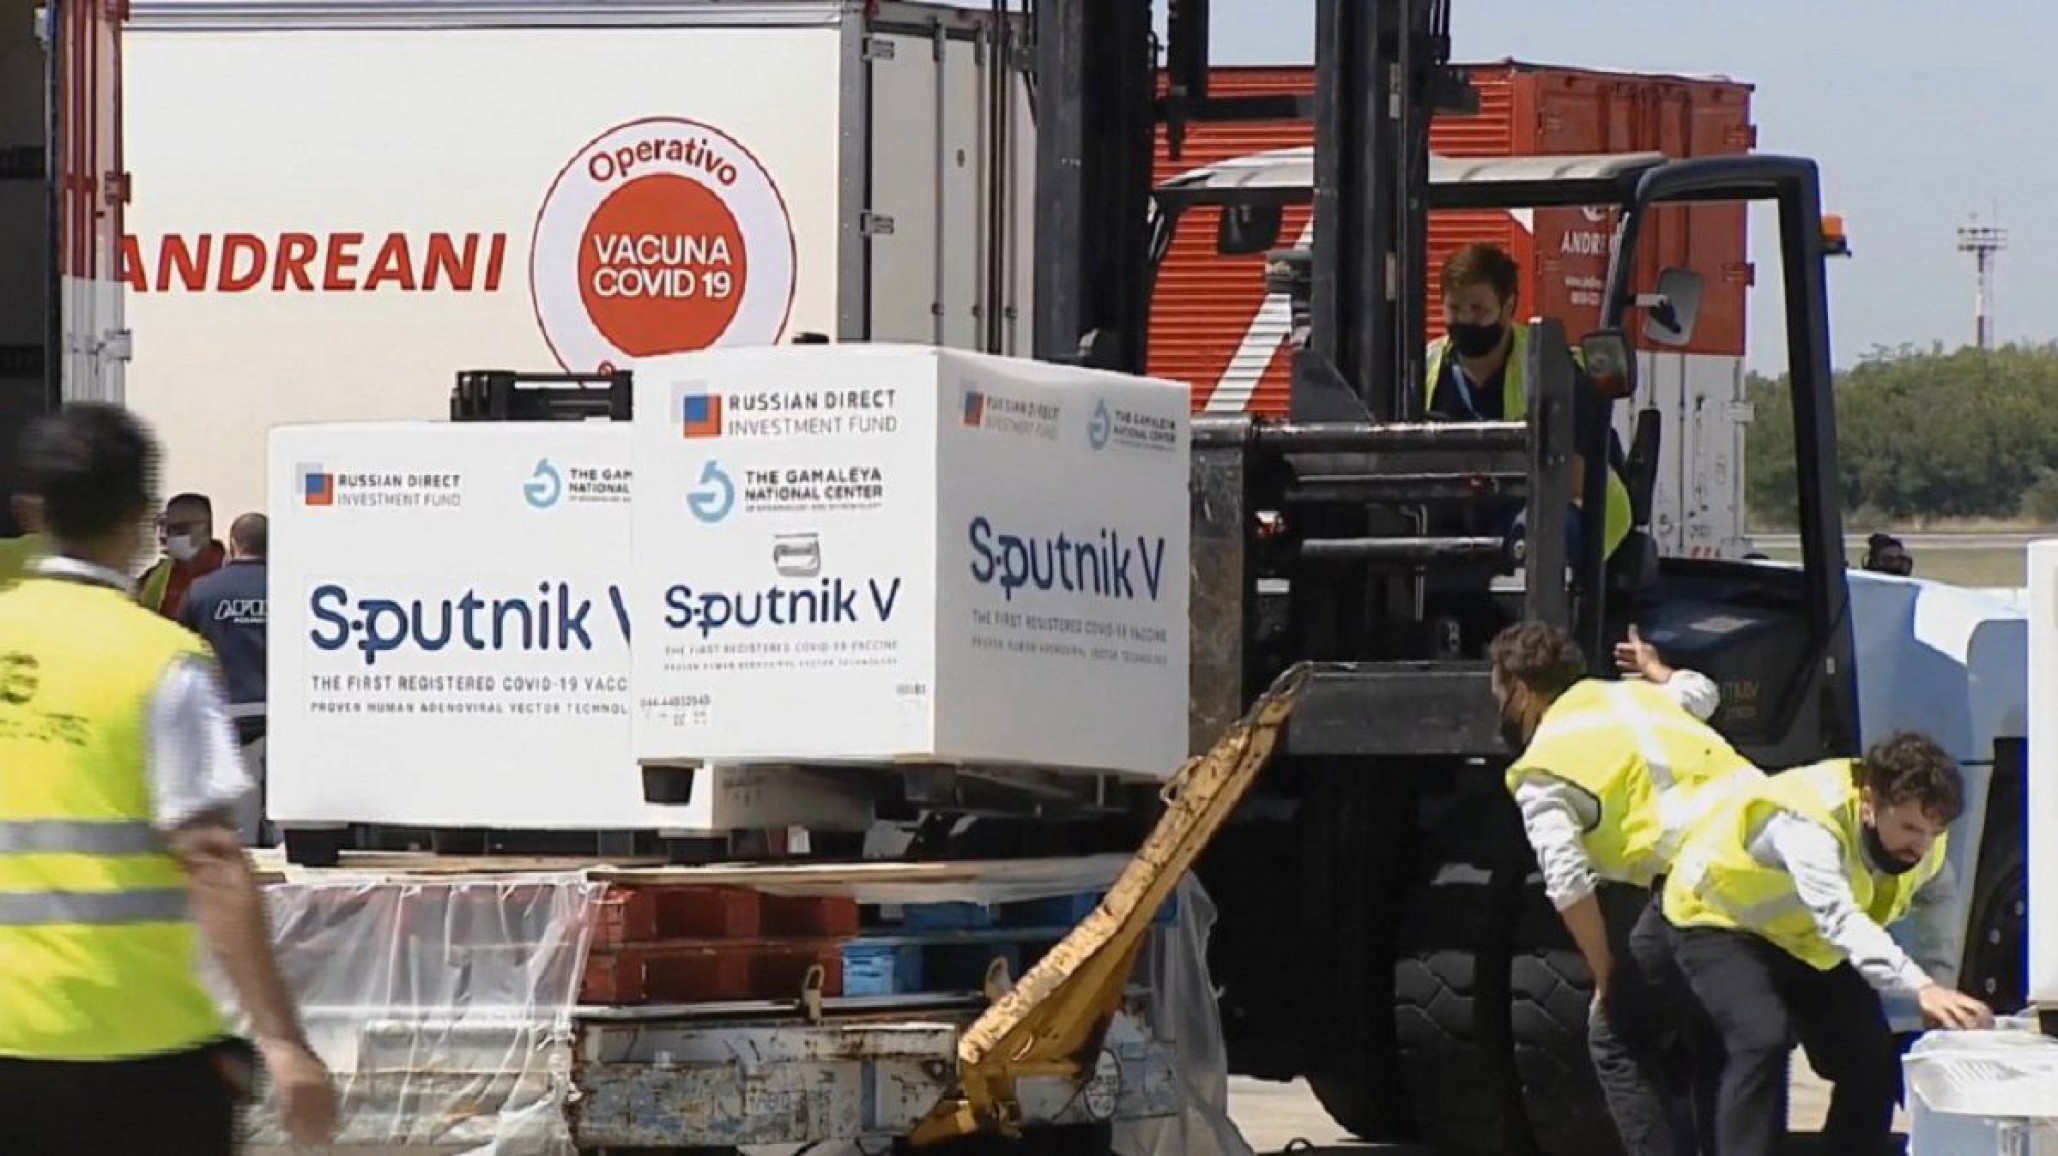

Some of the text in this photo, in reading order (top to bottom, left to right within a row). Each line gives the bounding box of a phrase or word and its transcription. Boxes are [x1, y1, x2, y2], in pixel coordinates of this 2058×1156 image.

[589, 138, 737, 185] Operativo
[593, 234, 731, 265] VACUNA
[123, 232, 506, 292] ANDREANI
[593, 269, 732, 297] COVID 19
[729, 389, 895, 410] RUSSIAN DIRECT
[728, 415, 897, 435] INVESTMENT FUND
[338, 474, 461, 488] RUSSIAN DIRECT
[569, 468, 597, 480] THE
[745, 466, 882, 485] THE GAMALEYA
[569, 481, 630, 494] NATIONAL
[745, 484, 883, 501] NATIONAL CENTER
[337, 493, 461, 507] INVESTMENT FUND
[969, 516, 1165, 602] Sputnik V
[665, 576, 901, 640] Sputnik V
[310, 580, 592, 665] Sputnik
[312, 675, 341, 691] THE
[347, 675, 392, 691] FIRST
[399, 675, 495, 691] REGISTERED
[502, 675, 578, 691] COVID-19
[310, 701, 360, 714] PROVEN
[366, 701, 414, 714] HUMAN
[510, 702, 561, 714] VECTOR
